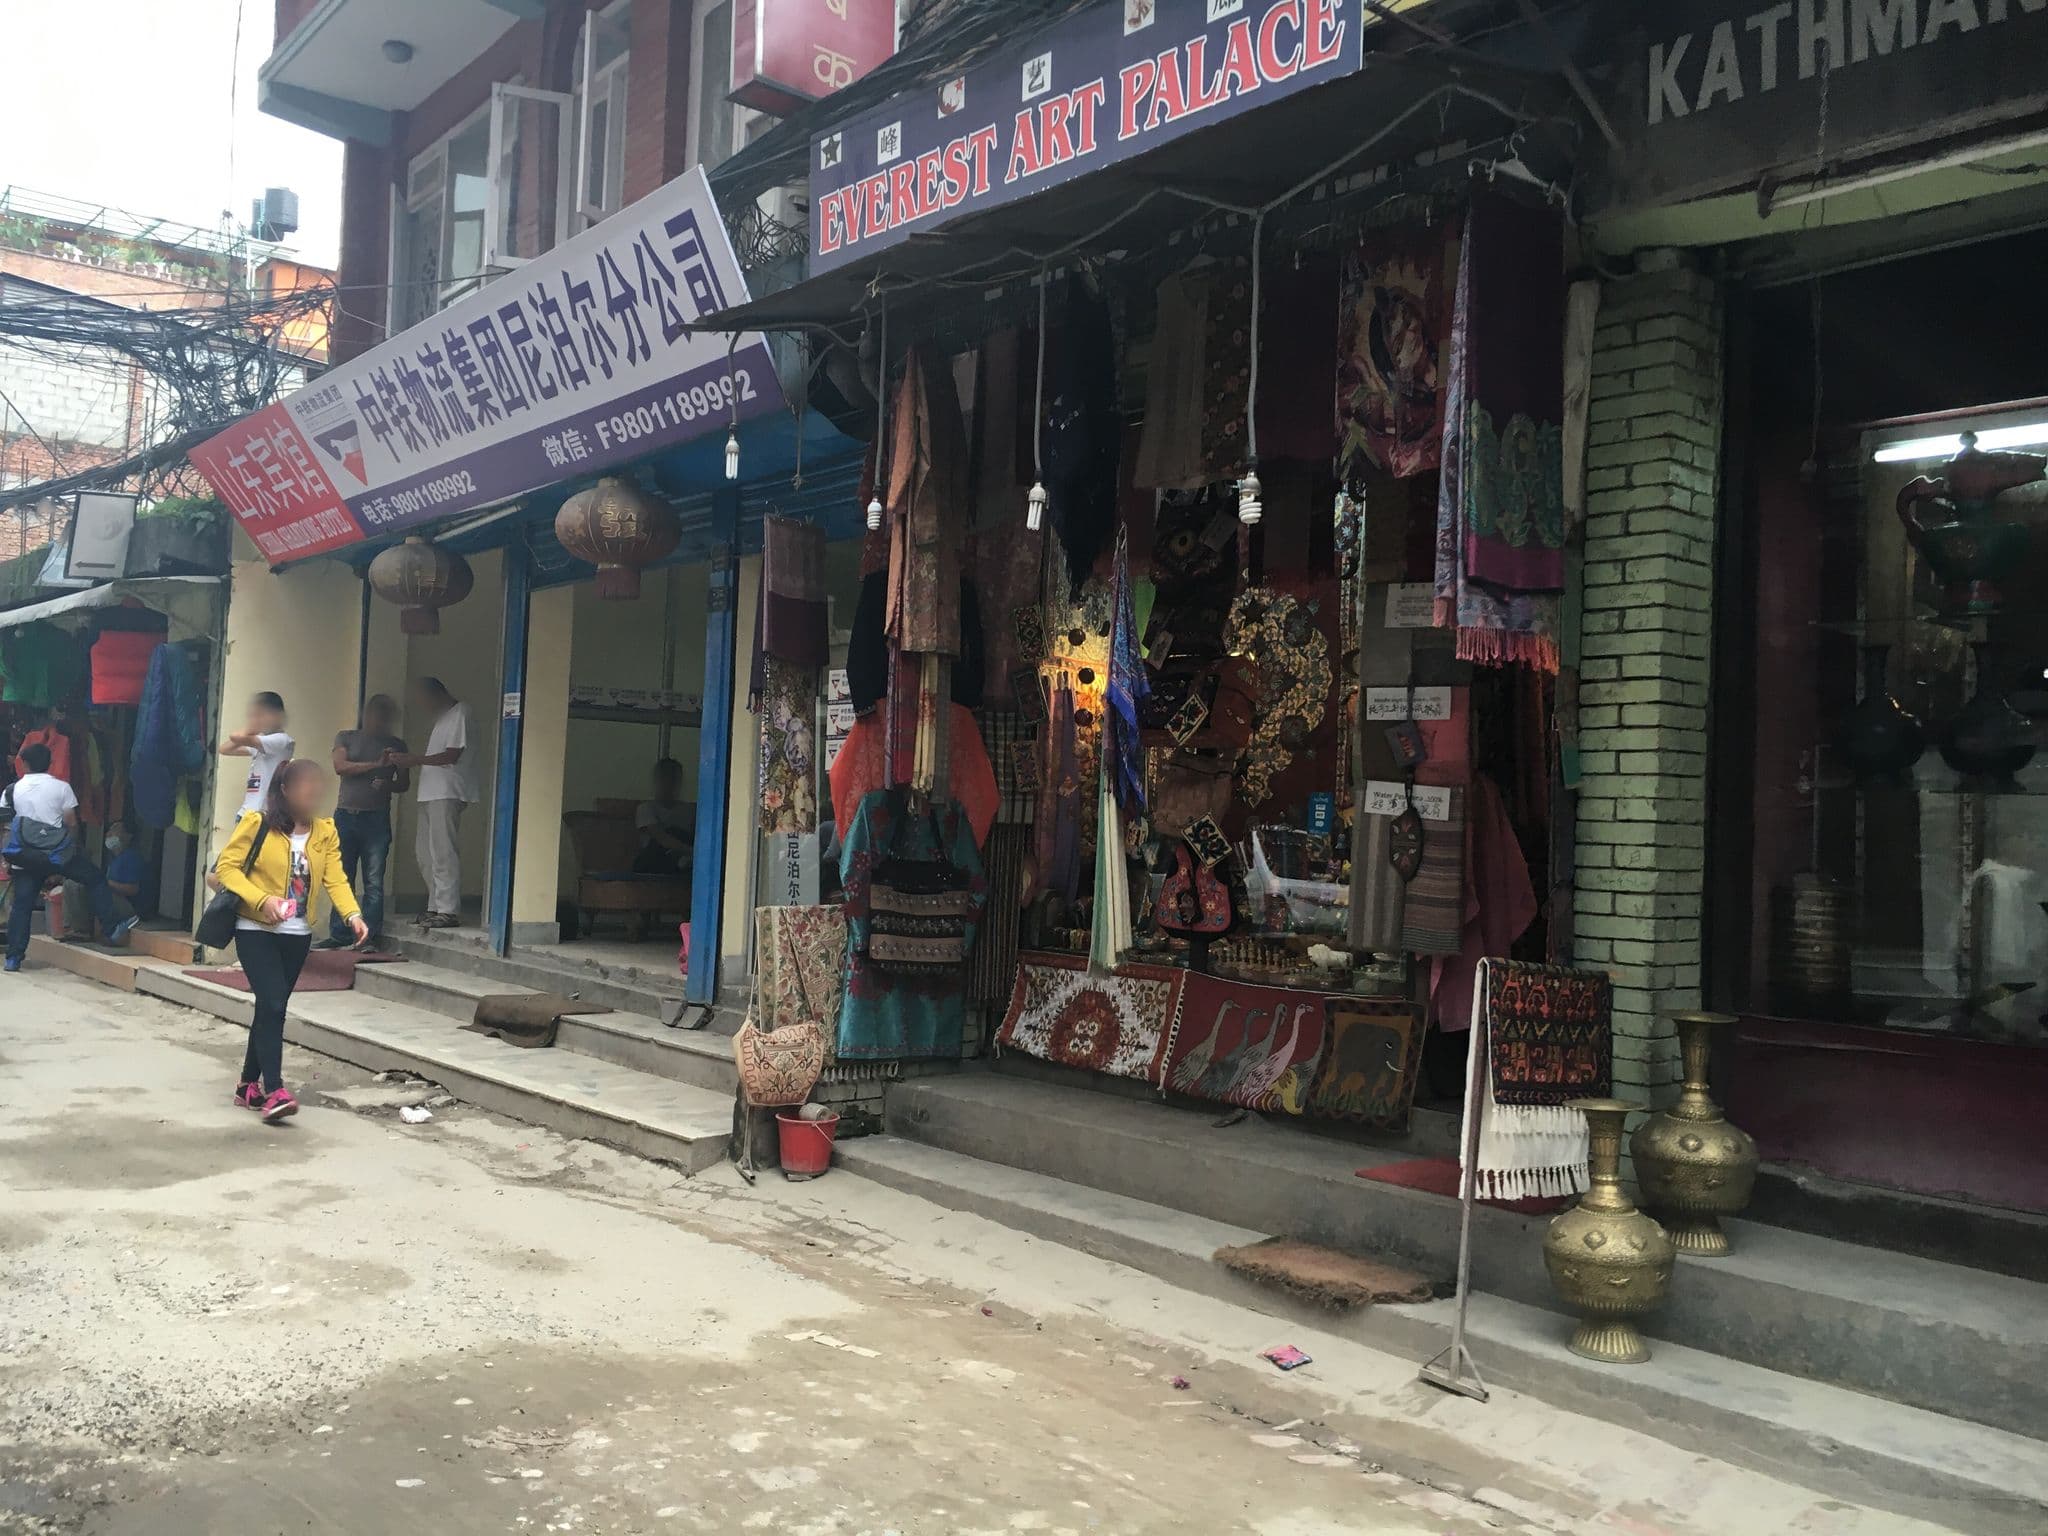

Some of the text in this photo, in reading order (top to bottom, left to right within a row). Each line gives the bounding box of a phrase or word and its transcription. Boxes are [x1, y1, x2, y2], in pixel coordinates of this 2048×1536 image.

[879, 57, 1046, 156] 峰 艺
[1647, 0, 2048, 126] KATHMA
[818, 0, 1346, 255] EVEREST ART PALACE
[353, 207, 730, 465] 中铁物流集团尼泊尔分公司
[206, 418, 330, 520] 山东宾馆
[540, 369, 758, 469] 微信: F9801189992
